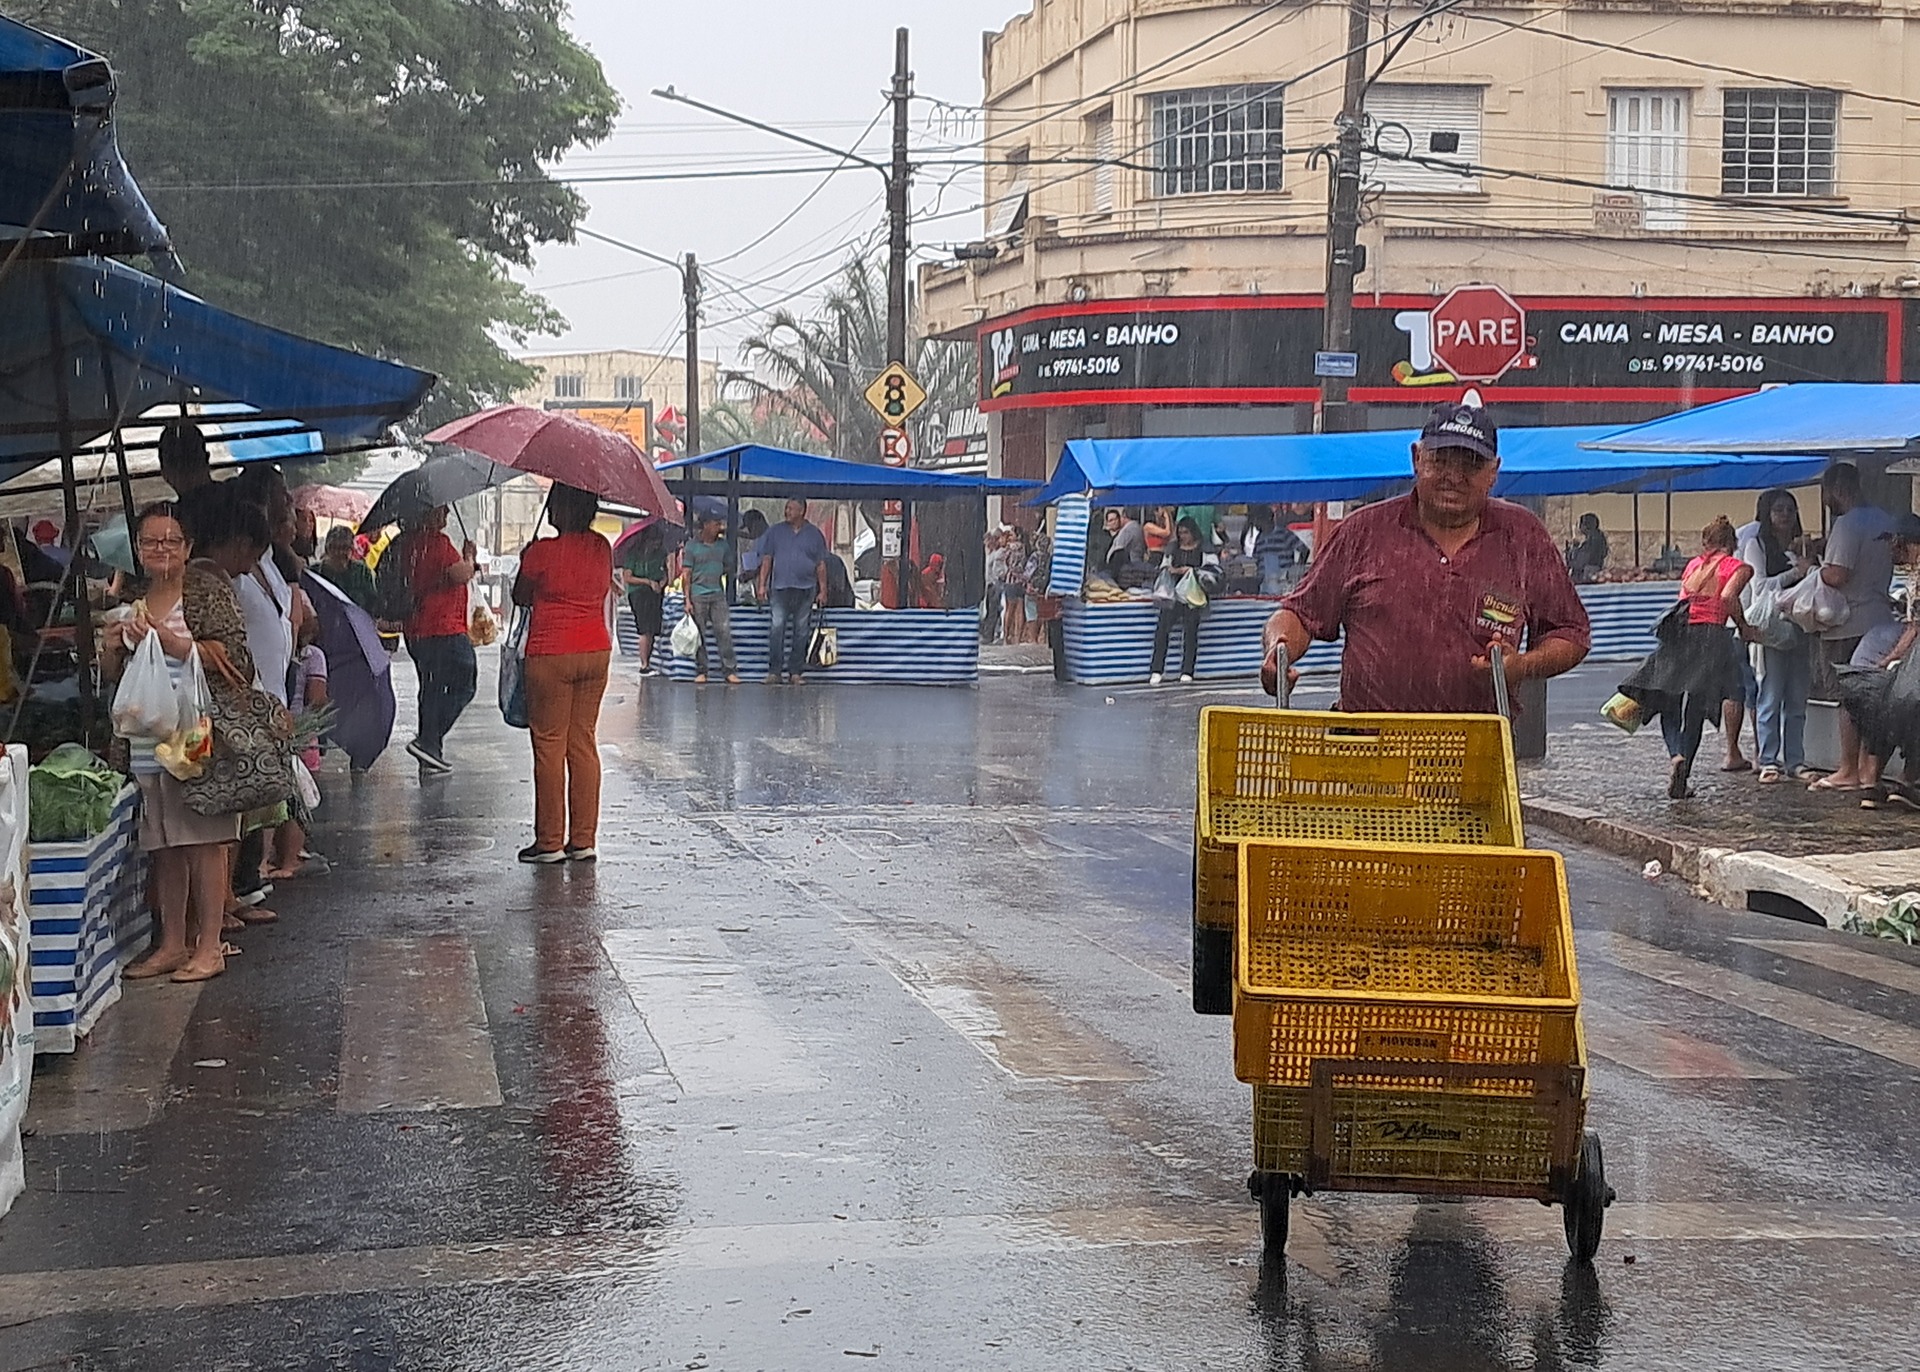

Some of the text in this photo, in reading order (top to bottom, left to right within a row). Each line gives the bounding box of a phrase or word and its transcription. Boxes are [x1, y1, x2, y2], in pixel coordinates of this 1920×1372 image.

[1049, 327, 1086, 349] MESA
[1105, 323, 1179, 346] BANHO
[1436, 318, 1520, 348] PARE
[1559, 322, 1630, 343] CAMA
[1657, 323, 1724, 344] MESA
[1751, 324, 1835, 344] BANHO
[1052, 355, 1121, 377] 99741-5016
[1662, 354, 1765, 372] 99741-5016
